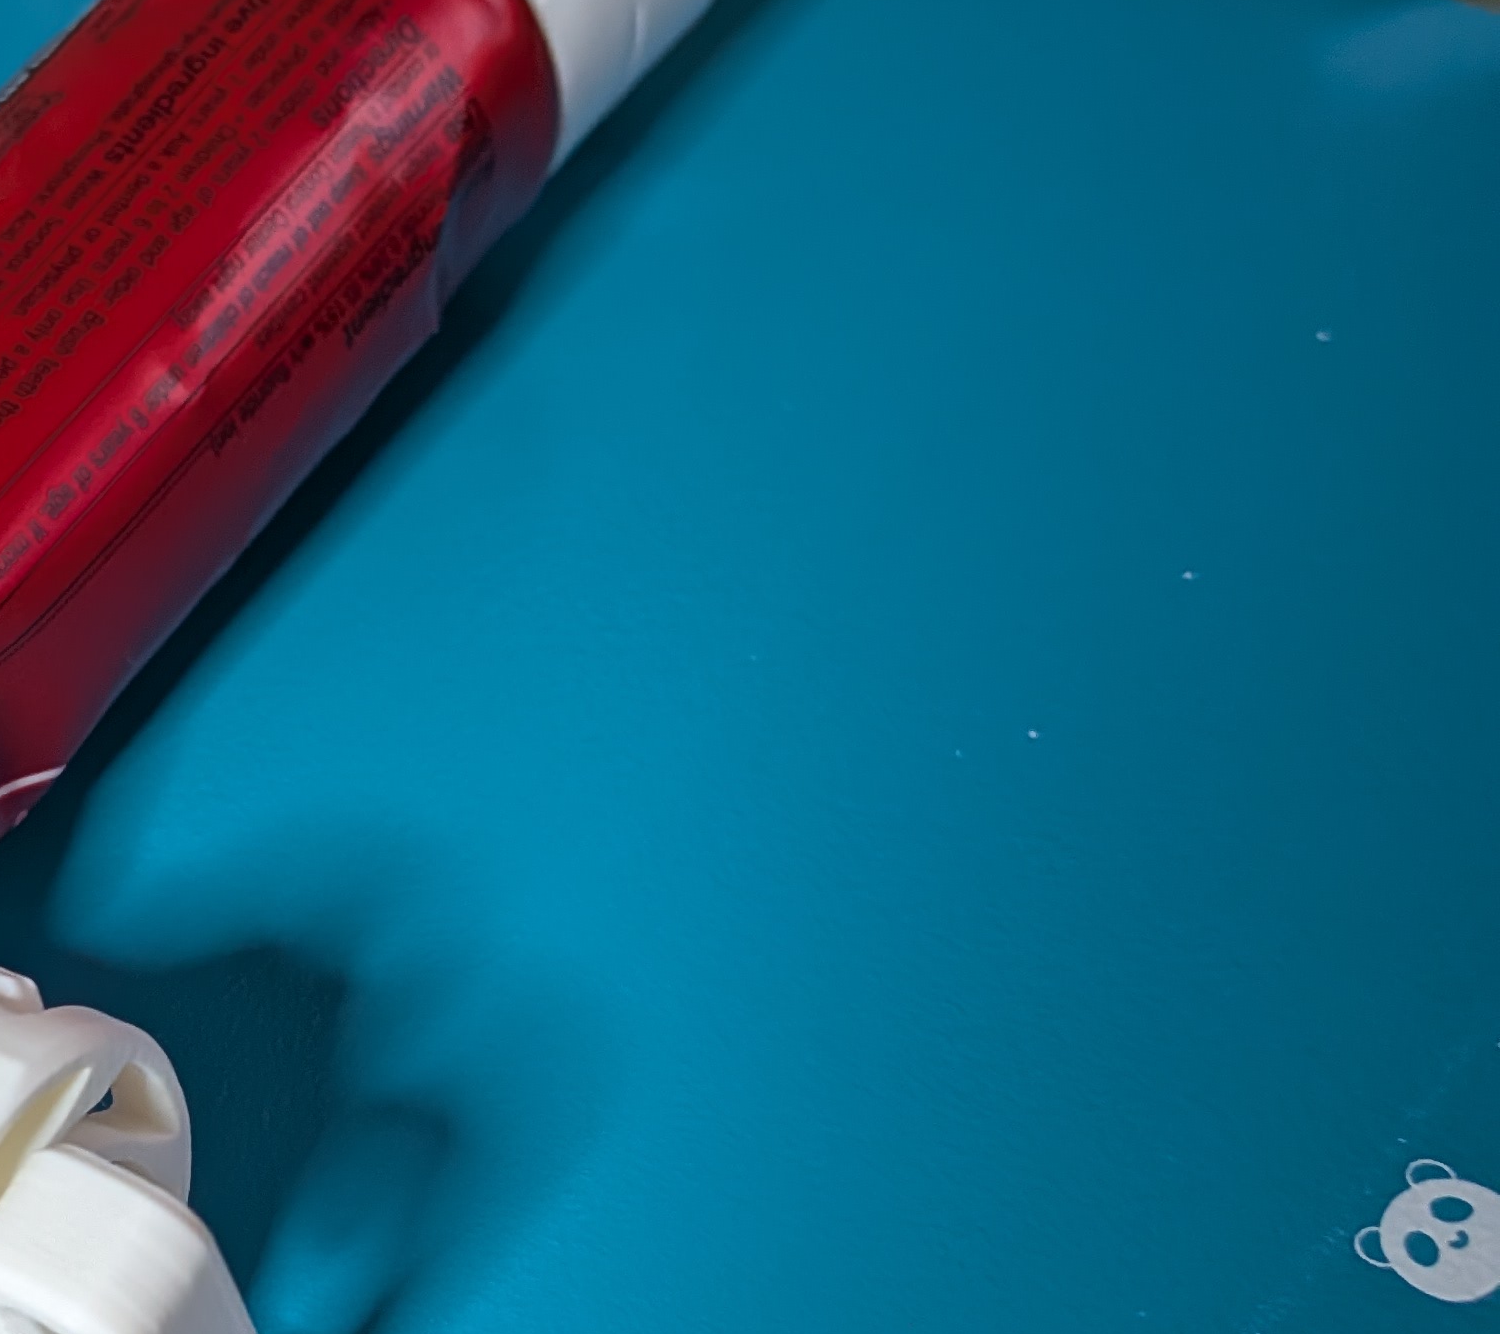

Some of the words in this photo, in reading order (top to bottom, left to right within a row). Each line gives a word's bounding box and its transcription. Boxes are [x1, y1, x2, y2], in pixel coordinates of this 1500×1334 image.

[103, 32, 229, 169] ingredients
[307, 14, 427, 131] Directions
[361, 67, 462, 165] Warnings
[12, 354, 59, 401] teeth
